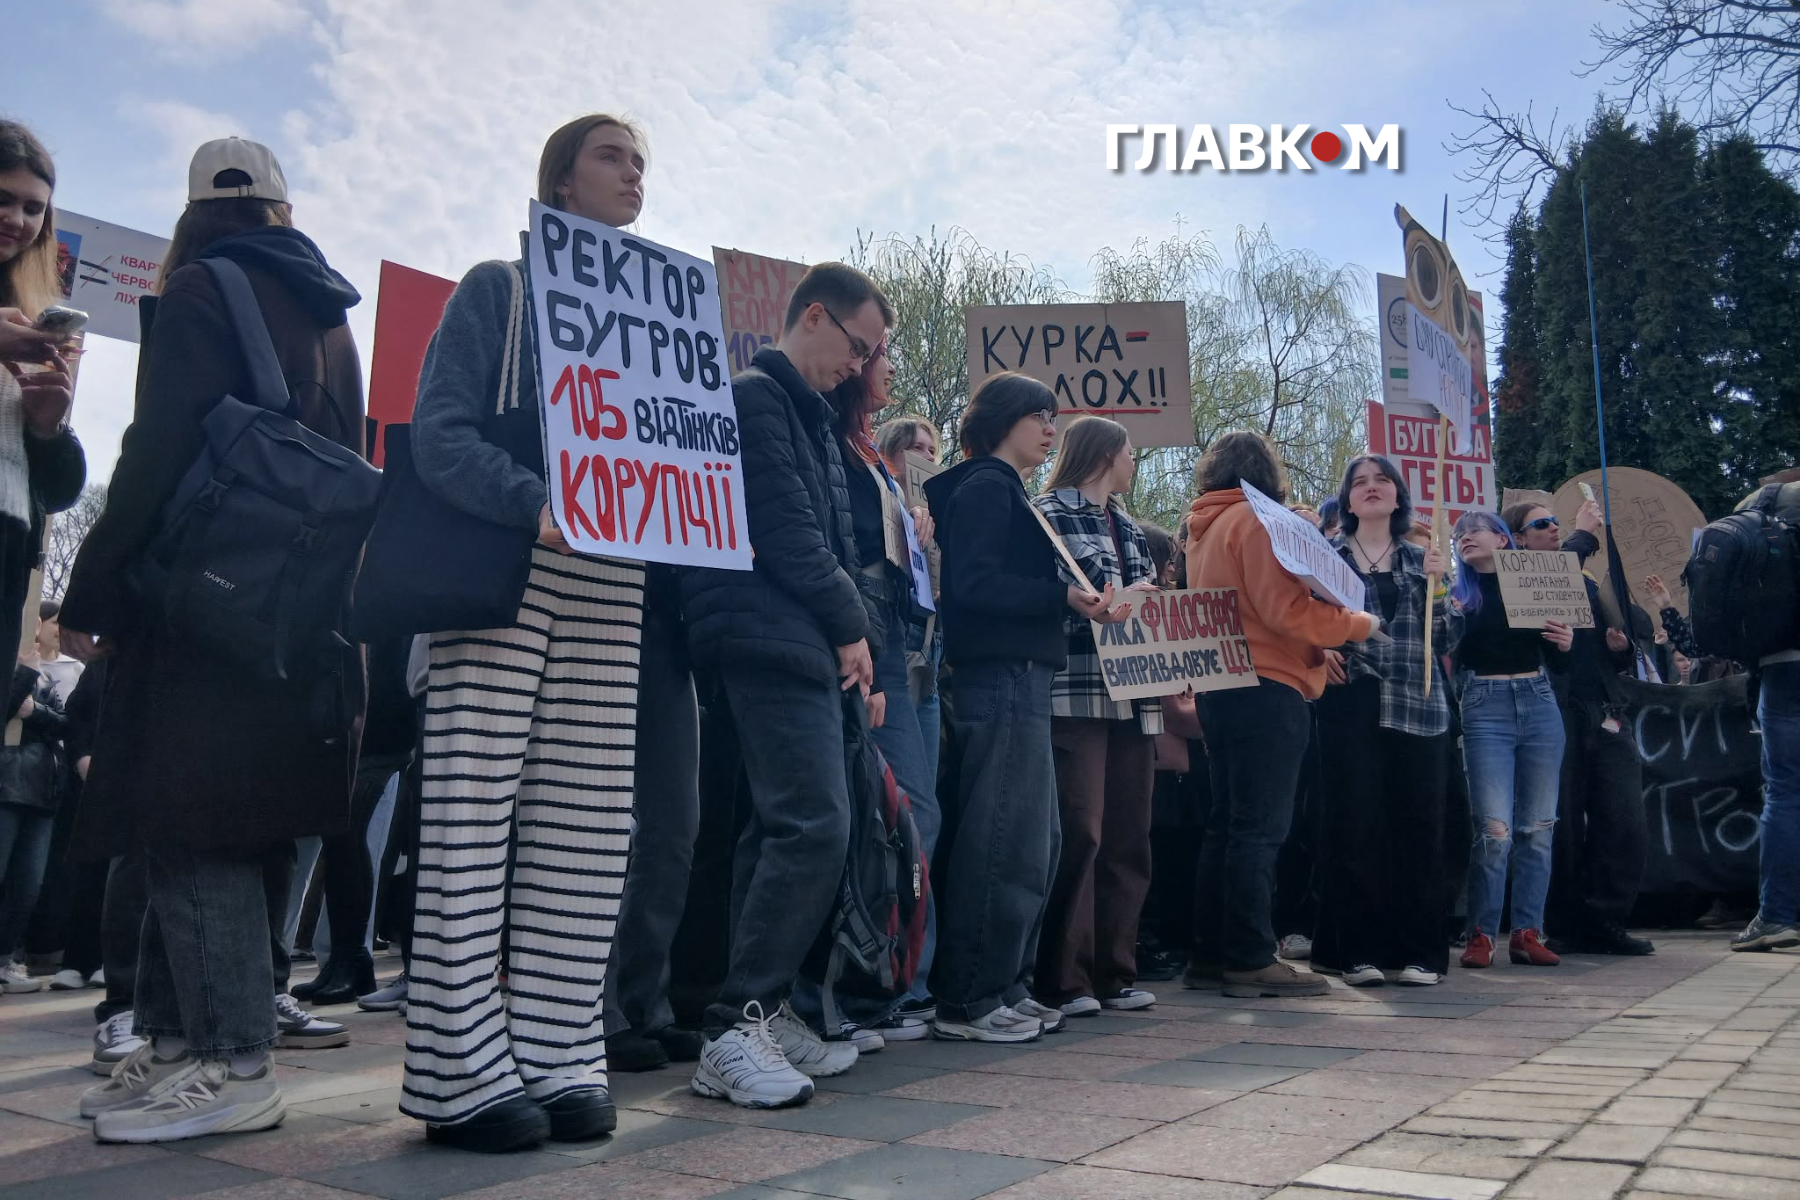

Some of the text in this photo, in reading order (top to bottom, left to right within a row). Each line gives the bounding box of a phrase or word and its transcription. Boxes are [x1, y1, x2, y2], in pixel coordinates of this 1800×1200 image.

[541, 213, 705, 321] РЕКТОР
[114, 292, 140, 305] ЛІХ
[1055, 367, 1167, 408] ЛОХ!!
[551, 364, 739, 455] 105 ВІДТІНКІВ
[1394, 419, 1487, 459] БУГОА
[560, 450, 737, 551] КОРУПЦІЇ
[1401, 459, 1485, 505] ГЕТЬ!
[1499, 552, 1569, 572] КОРУПЦІЯ
[1518, 576, 1571, 588] ДОМАГАННЯ
[1141, 590, 1245, 642] ФІЛОСОФІЯ
[1533, 591, 1544, 601] ДО
[1103, 639, 1254, 687] ВИПРАВДОВУЄ ЦЕ?
